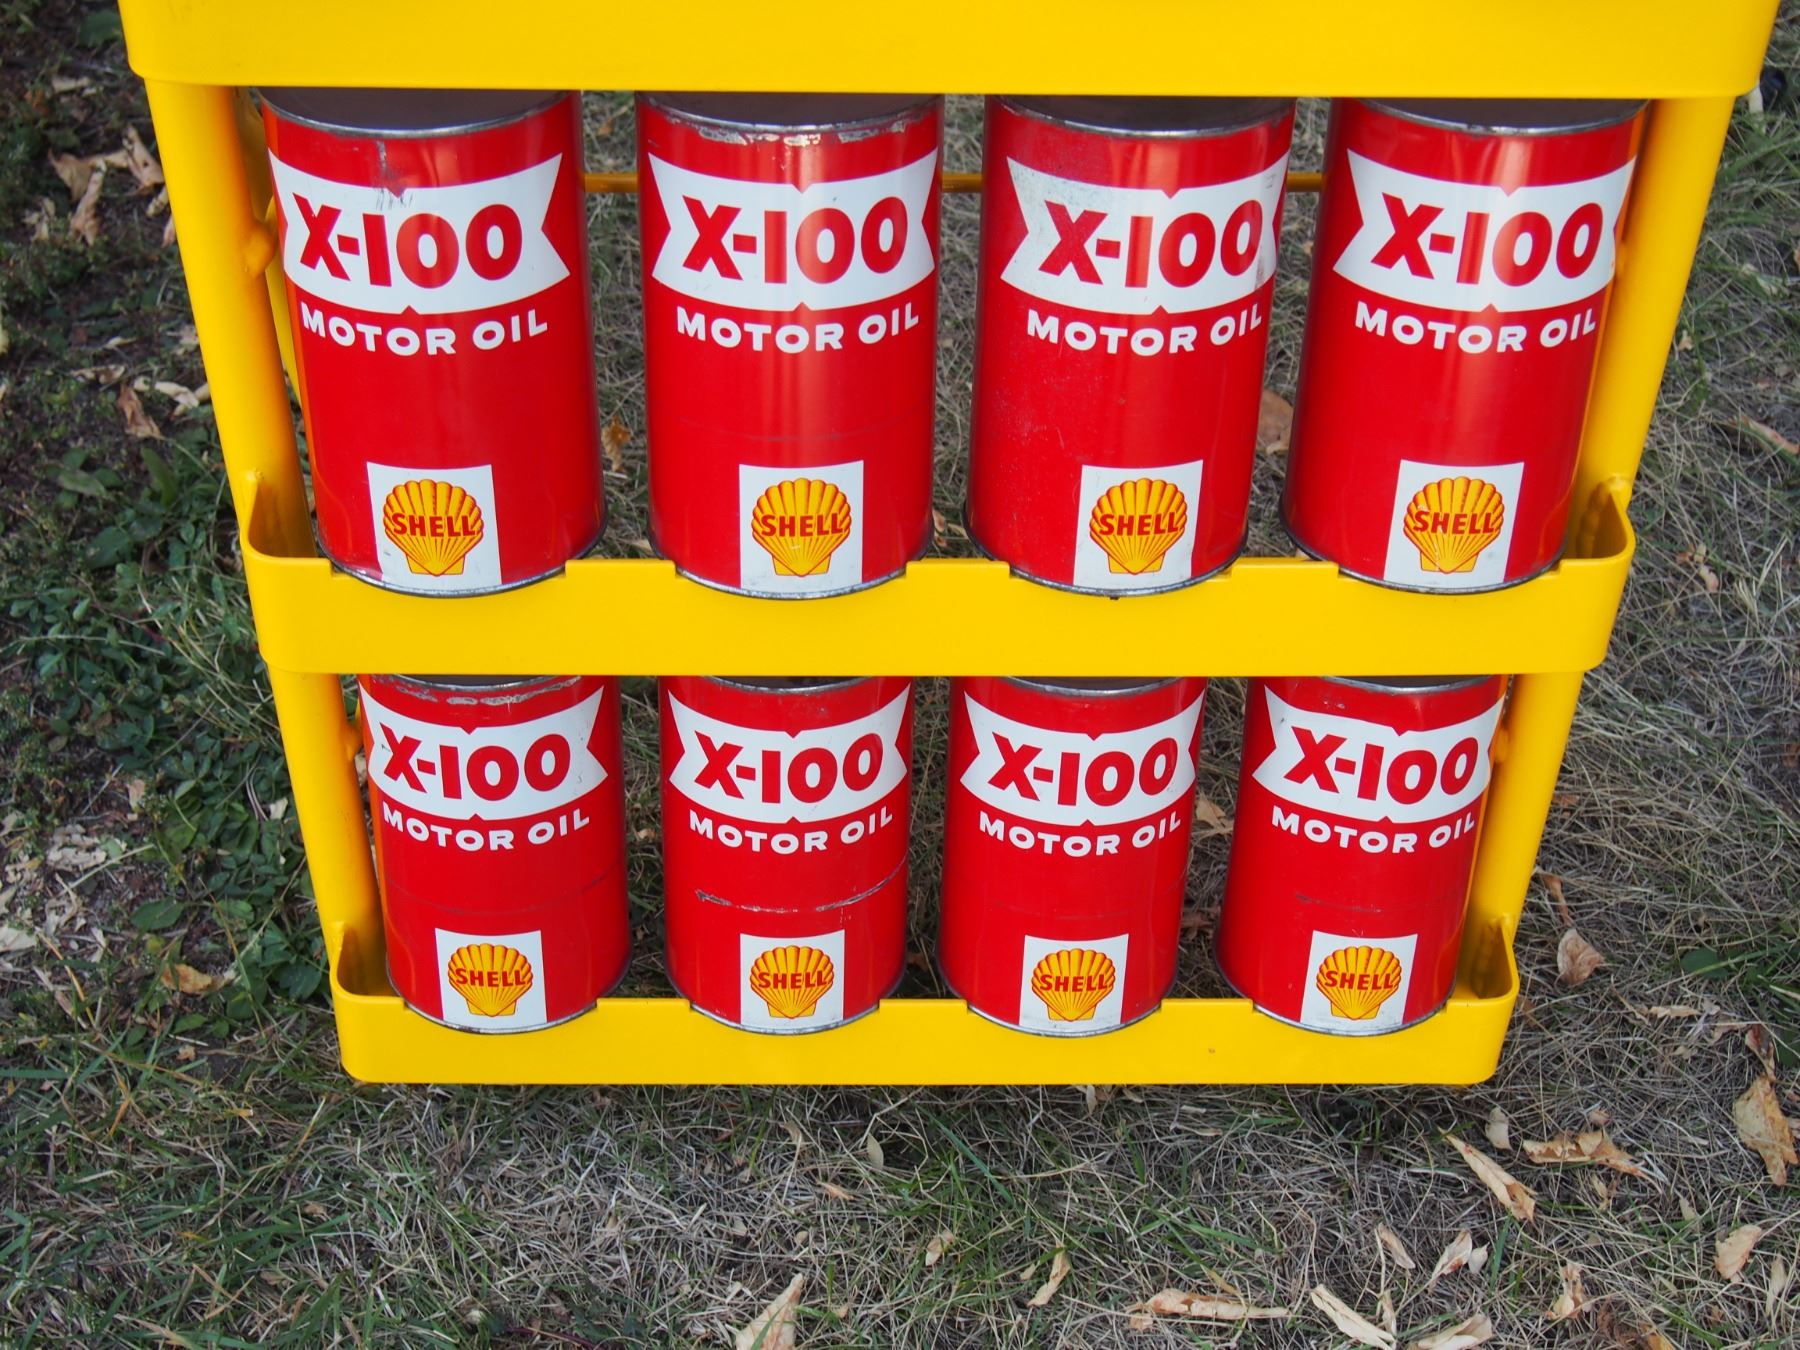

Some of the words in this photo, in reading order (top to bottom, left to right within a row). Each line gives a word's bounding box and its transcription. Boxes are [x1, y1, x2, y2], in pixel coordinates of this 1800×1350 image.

[292, 192, 522, 289] X-100
[682, 194, 909, 285] X-100
[1038, 198, 1263, 288] X-100
[1371, 192, 1604, 288] X-100
[300, 302, 456, 356] MOTOR
[472, 308, 549, 344] OIL
[676, 306, 842, 354] MOTOR
[858, 302, 920, 344] OIL
[1027, 309, 1196, 356] MOTOR
[1211, 303, 1262, 344] OIL
[1355, 302, 1523, 354] MOTOR
[1540, 309, 1596, 348] OIL
[392, 512, 478, 538] SHELL
[760, 513, 846, 537] SHELL
[1099, 512, 1182, 536] SHELL
[1412, 508, 1497, 534] SHELL
[379, 722, 571, 801] X-100
[694, 730, 884, 804] X-100
[987, 731, 1178, 807] X-100
[1283, 726, 1478, 805] X-100
[382, 801, 514, 851] MOTOR
[527, 808, 590, 844] OIL
[689, 809, 828, 855] MOTOR
[840, 806, 894, 843] OIL
[979, 811, 1119, 857] MOTOR
[1132, 813, 1181, 847] OIL
[1272, 805, 1415, 854] MOTOR
[1429, 814, 1475, 848] OIL
[454, 968, 529, 988] SHELL
[757, 971, 830, 990] SHELL
[1039, 973, 1111, 993] SHELL
[1324, 969, 1396, 991] SHELL
